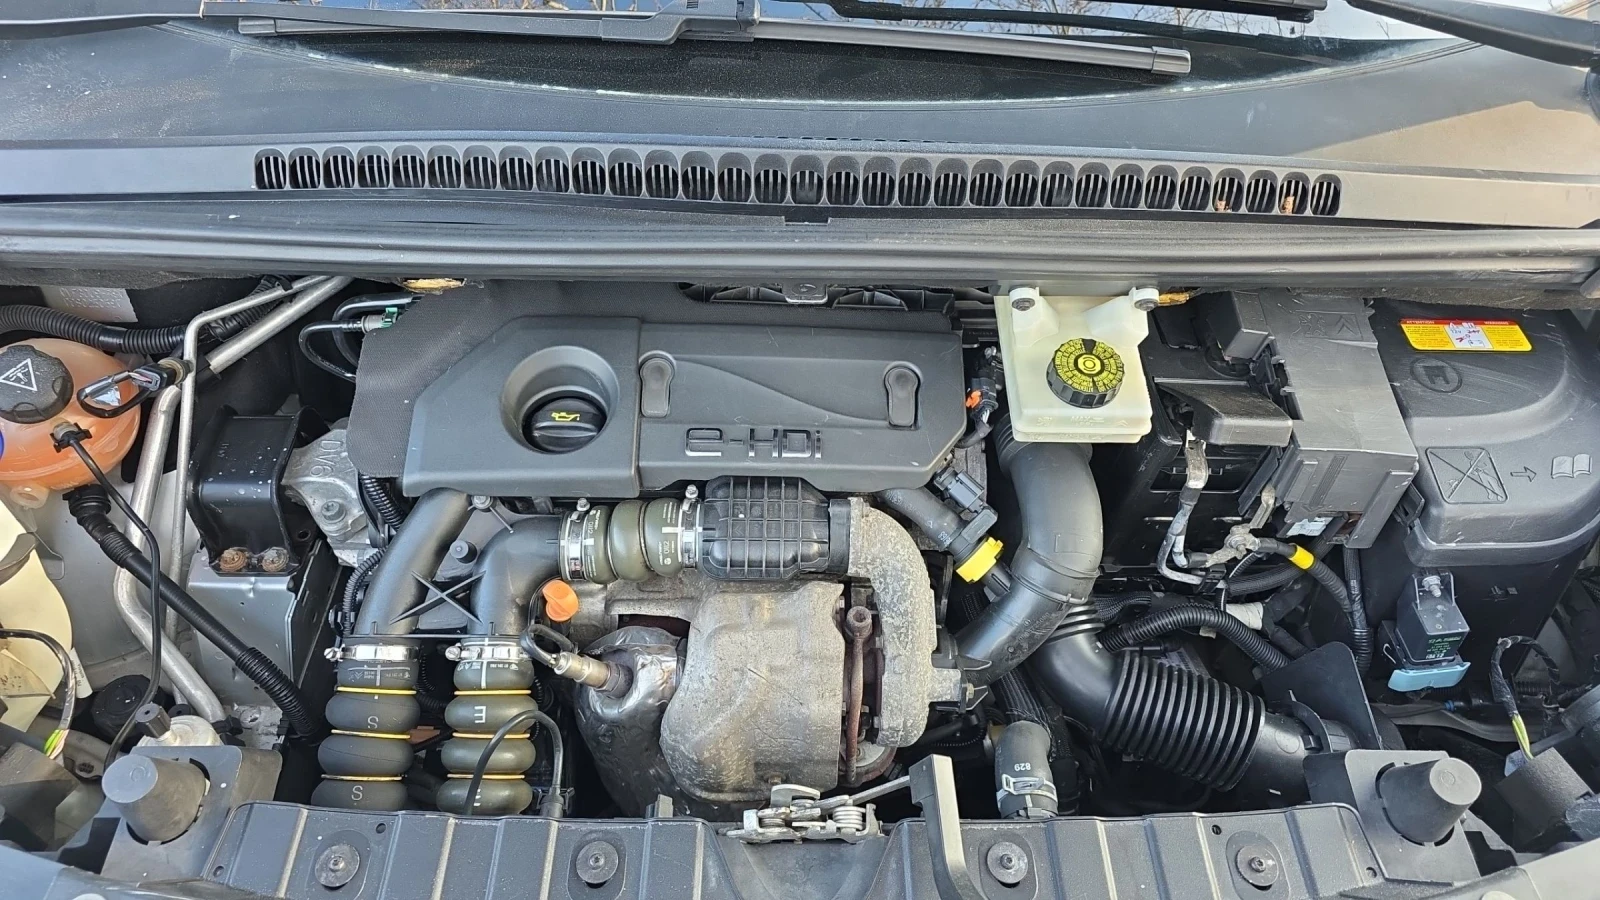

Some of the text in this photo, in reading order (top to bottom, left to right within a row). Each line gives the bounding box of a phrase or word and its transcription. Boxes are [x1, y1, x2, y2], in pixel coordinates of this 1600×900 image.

[685, 427, 822, 459] e-HDi
[310, 440, 344, 477] DV6
[367, 715, 379, 729] S
[473, 705, 487, 723] E
[1014, 762, 1031, 771] 829
[351, 785, 363, 801] S
